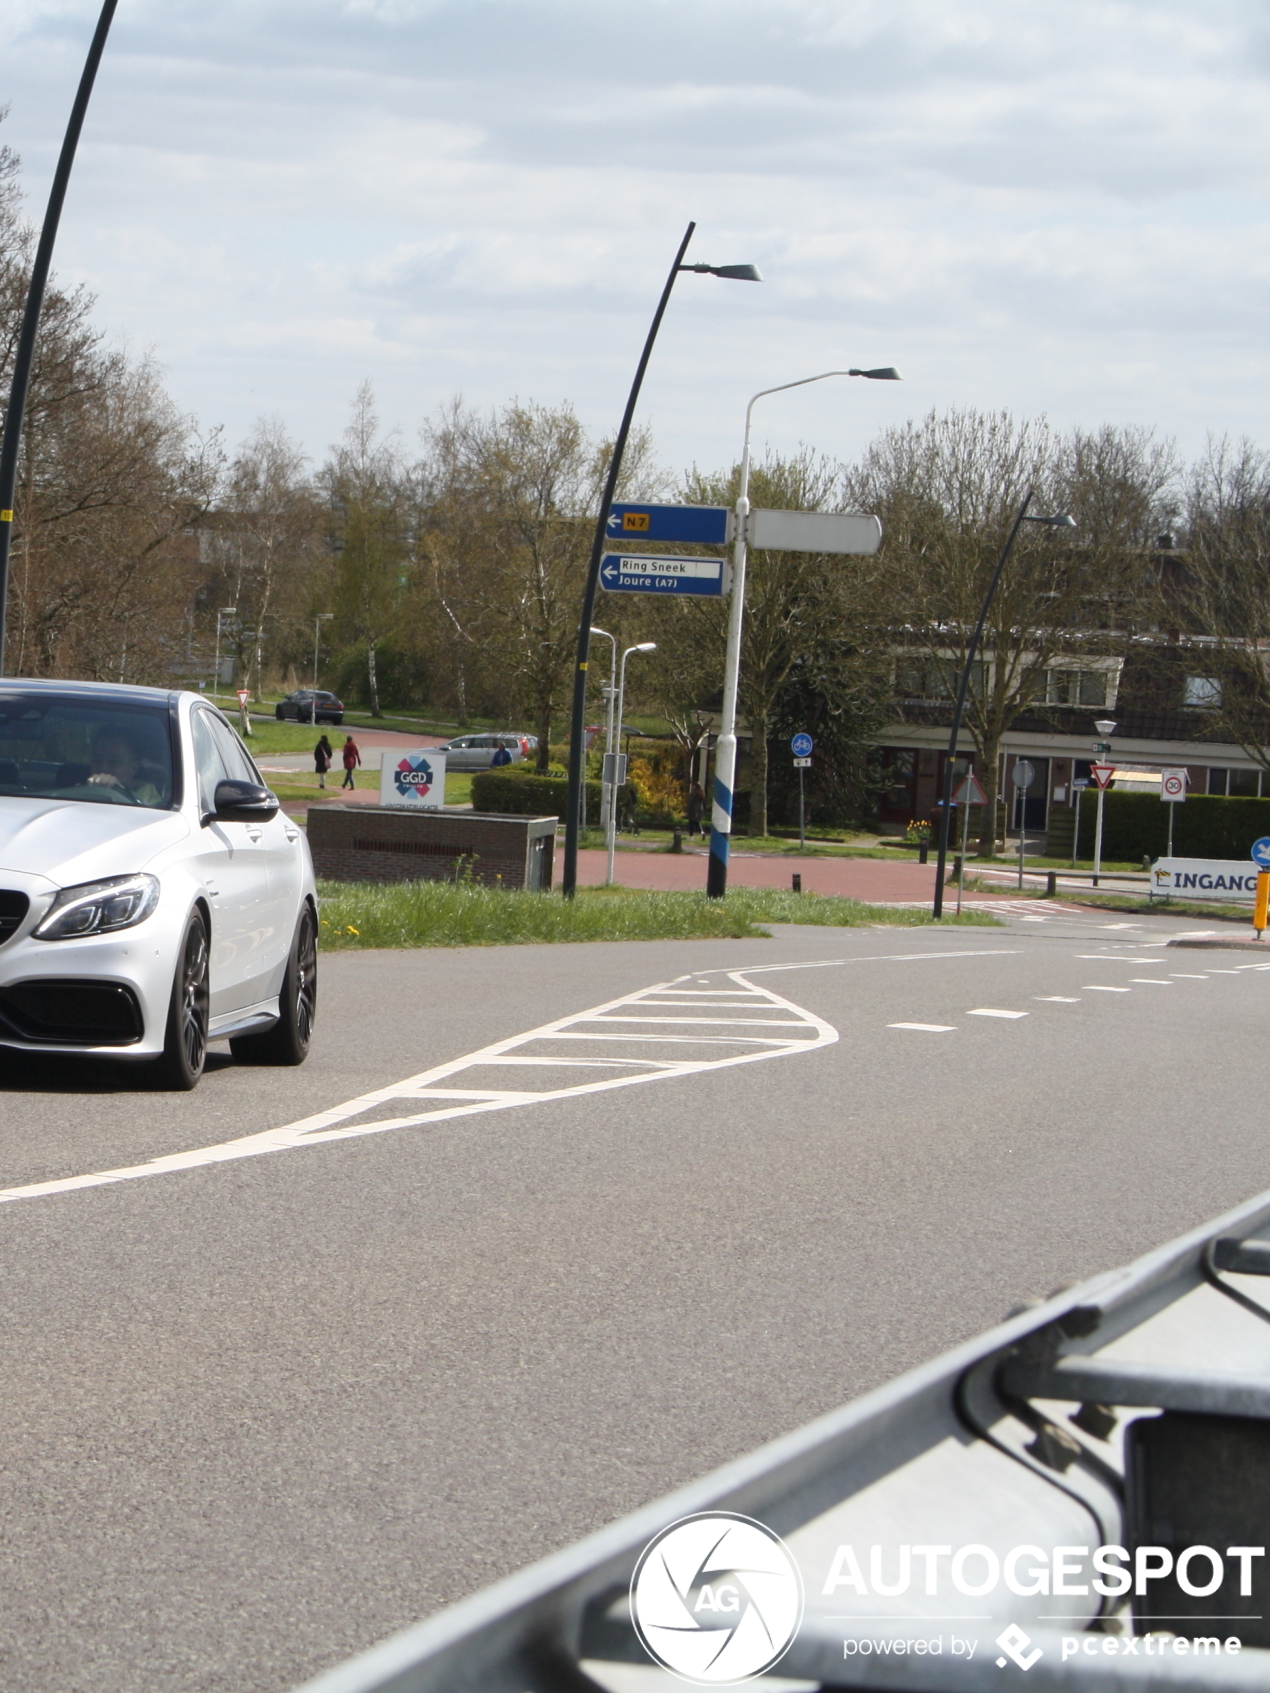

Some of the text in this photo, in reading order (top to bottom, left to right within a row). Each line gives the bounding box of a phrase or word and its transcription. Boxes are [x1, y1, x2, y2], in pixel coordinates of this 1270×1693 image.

[622, 560, 686, 573] Ring Sneek
[618, 575, 677, 588] Joure (A7)
[400, 772, 427, 783] GGD
[1167, 782, 1180, 790] 30
[1174, 872, 1258, 892] INGANG
